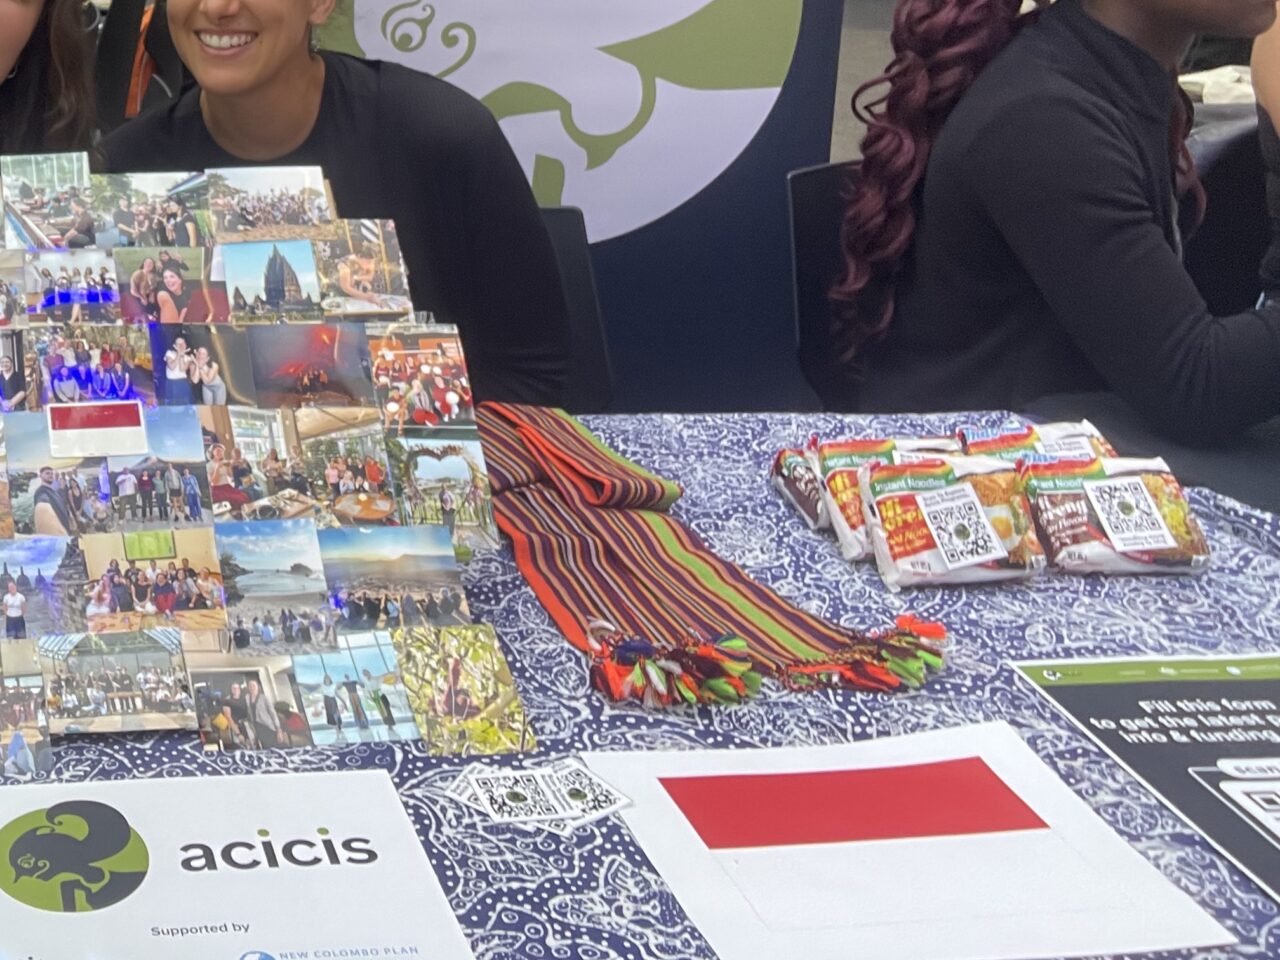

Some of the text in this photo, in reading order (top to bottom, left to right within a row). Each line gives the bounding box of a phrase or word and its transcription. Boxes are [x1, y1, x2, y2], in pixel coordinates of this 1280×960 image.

[874, 477, 946, 492] Instant Noodles
[1138, 698, 1277, 713] Fill this form
[1089, 717, 1117, 729] to
[1119, 716, 1159, 731] get
[1158, 715, 1198, 728] the
[1197, 713, 1266, 727] latest
[1169, 729, 1191, 743] &
[1189, 728, 1280, 743] funding
[179, 827, 379, 872] acicis
[150, 922, 250, 938] Supported by
[279, 945, 419, 960] NEW COLOMBO PLAN
